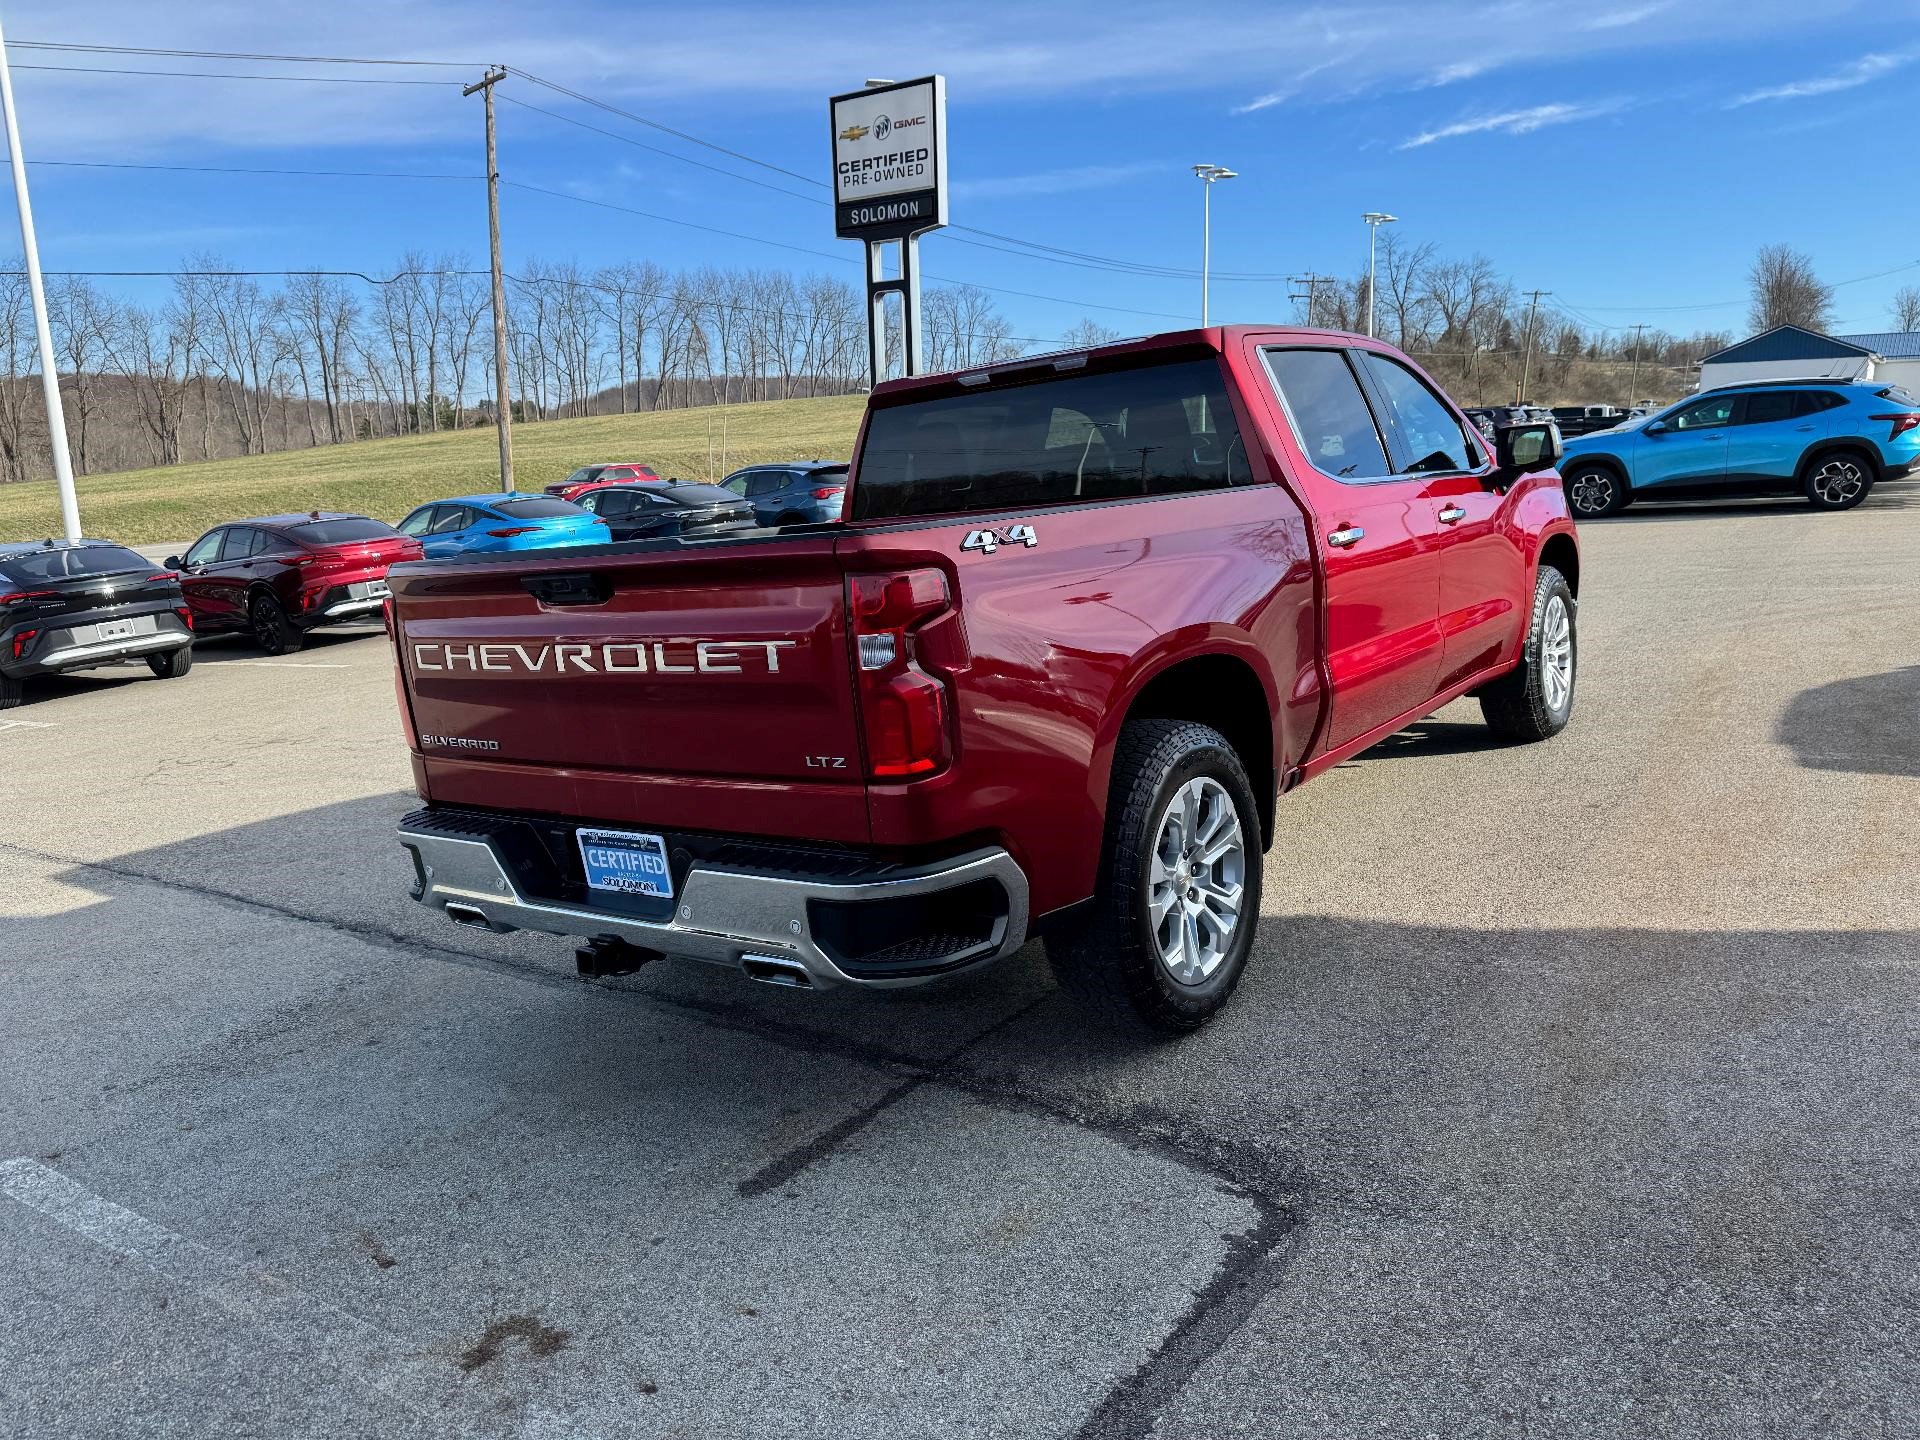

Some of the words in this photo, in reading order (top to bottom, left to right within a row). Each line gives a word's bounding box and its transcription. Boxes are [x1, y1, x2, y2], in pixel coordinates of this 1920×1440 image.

[893, 116, 926, 130] GMC
[838, 148, 929, 175] CERTIFIED
[843, 163, 924, 187] PRE-OWNED
[851, 201, 919, 225] SOLOMON
[414, 640, 797, 673] CHEVROLET
[422, 734, 499, 750] SILVERADO
[805, 756, 847, 768] LTZ
[588, 849, 665, 875] CERTIFIED
[602, 877, 655, 892] SOLOMON
